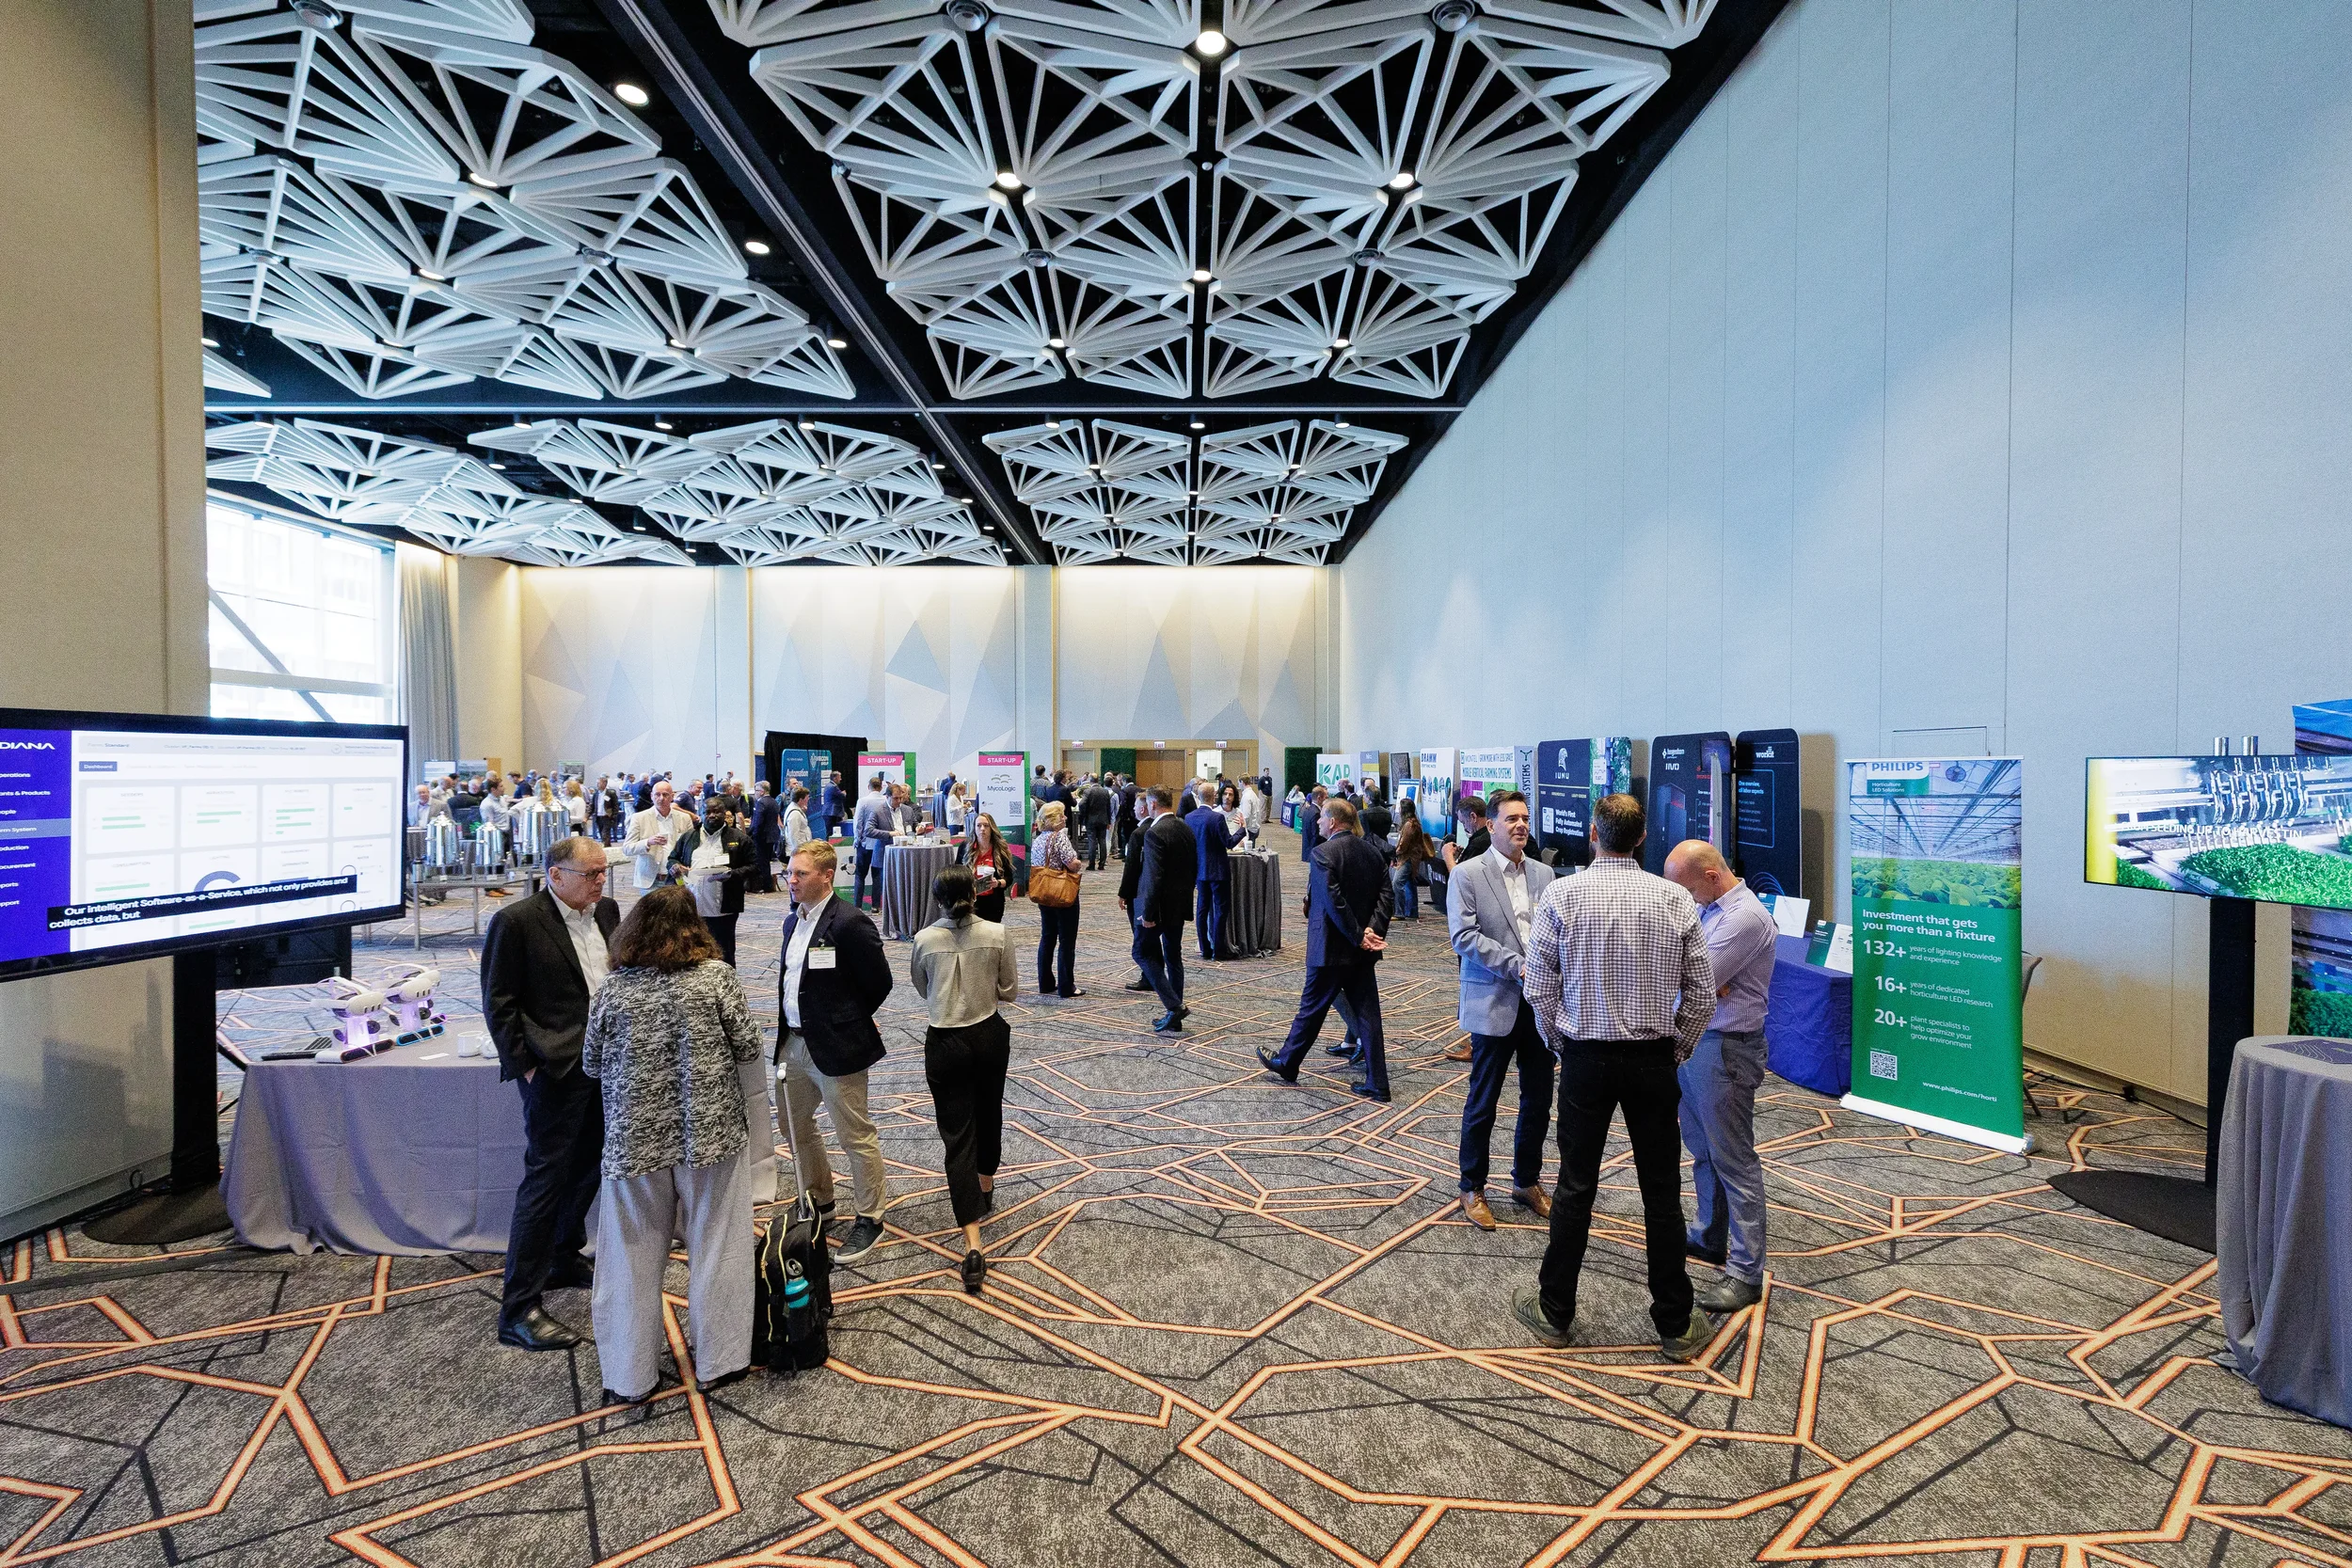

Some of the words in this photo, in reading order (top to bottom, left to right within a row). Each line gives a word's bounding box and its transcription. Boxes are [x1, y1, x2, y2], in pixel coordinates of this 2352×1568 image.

[1872, 762, 1923, 771] PHILIPS
[1522, 764, 1531, 790] SYSTEMS
[1564, 819, 1582, 828] Automated
[1564, 828, 1583, 837] Registration
[2152, 824, 2194, 833] SEEDING
[2197, 825, 2214, 835] UP
[2216, 827, 2230, 836] TO
[64, 907, 86, 916] Our
[87, 901, 139, 913] intelligent
[139, 890, 243, 907] Software-as-a-Service,
[244, 886, 268, 895] which
[283, 882, 300, 891] only
[301, 879, 332, 890] provides
[49, 916, 93, 928] collects
[95, 914, 121, 923] data,
[122, 911, 141, 920] but
[1863, 910, 1924, 924] Investment
[1926, 915, 1949, 926] that
[1952, 919, 1978, 929] gets
[1863, 921, 1883, 930] you
[1886, 923, 1914, 934] more
[1916, 926, 1943, 937] than
[1955, 930, 1995, 942] fixture
[1863, 940, 1906, 958] 132+
[1936, 947, 1962, 958] lighting
[1963, 951, 2002, 963] knowledge
[1924, 957, 1960, 966] experience
[1875, 975, 1907, 993] 16+
[1936, 985, 1970, 995] dedicated
[1910, 990, 1948, 1001] horticulture
[1964, 998, 1994, 1008] research
[1874, 1008, 1907, 1027] 20+
[1911, 1015, 1927, 1023] plant
[1929, 1018, 1961, 1030] specialists
[1911, 1023, 1925, 1033] help
[1926, 1027, 1955, 1037] optimize
[1911, 1034, 1928, 1042] grow
[1929, 1037, 1972, 1049] environment
[1922, 1082, 1997, 1102] www.philips.com/horti
